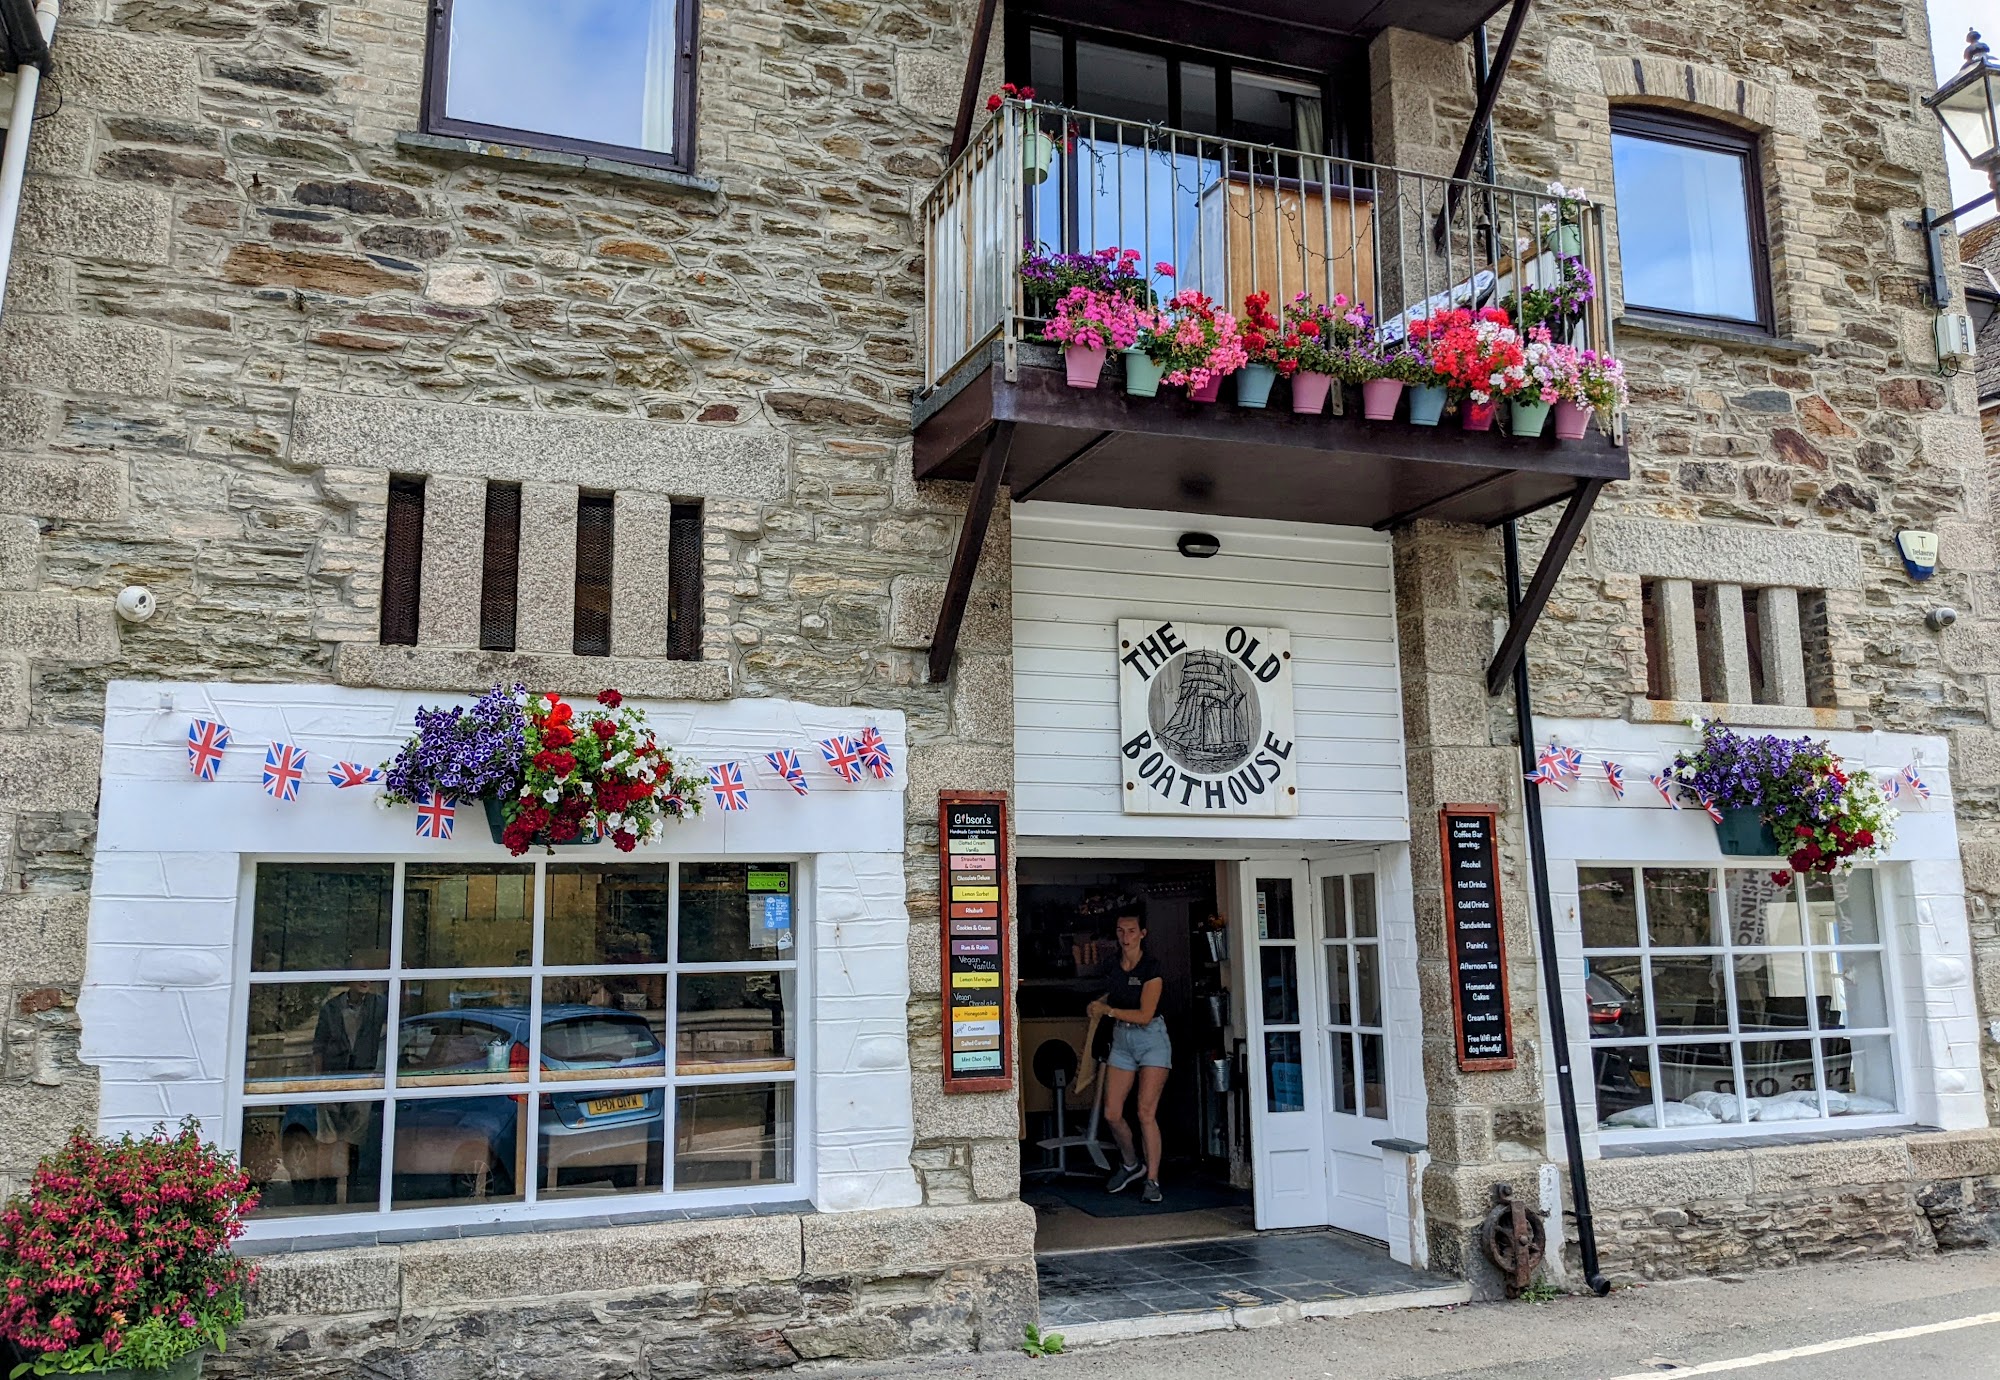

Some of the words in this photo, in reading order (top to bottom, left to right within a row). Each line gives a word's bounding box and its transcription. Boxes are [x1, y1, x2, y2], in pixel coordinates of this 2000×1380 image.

[1960, 317, 1968, 352] C128
[1121, 621, 1188, 682] THE
[1225, 626, 1281, 683] OLD
[1121, 729, 1293, 809] BOATHOUSE
[954, 813, 992, 824] Gibson's
[1453, 830, 1471, 838] Coffee
[1472, 830, 1483, 838] Bar
[1754, 880, 1774, 945] RCHARDS
[1459, 921, 1492, 929] Sandwiches
[958, 956, 981, 965] Vegan
[1460, 962, 1487, 970] Afternoon
[1487, 961, 1498, 969] Tea
[1465, 982, 1496, 990] Homemade
[953, 993, 972, 1003] Vegan
[1472, 992, 1490, 1001] Cakes
[1467, 1013, 1485, 1022] Cream
[1485, 1013, 1499, 1021] Teas
[1467, 1034, 1480, 1042] Free
[1491, 1033, 1502, 1041] and
[1469, 1045, 1480, 1054] dog
